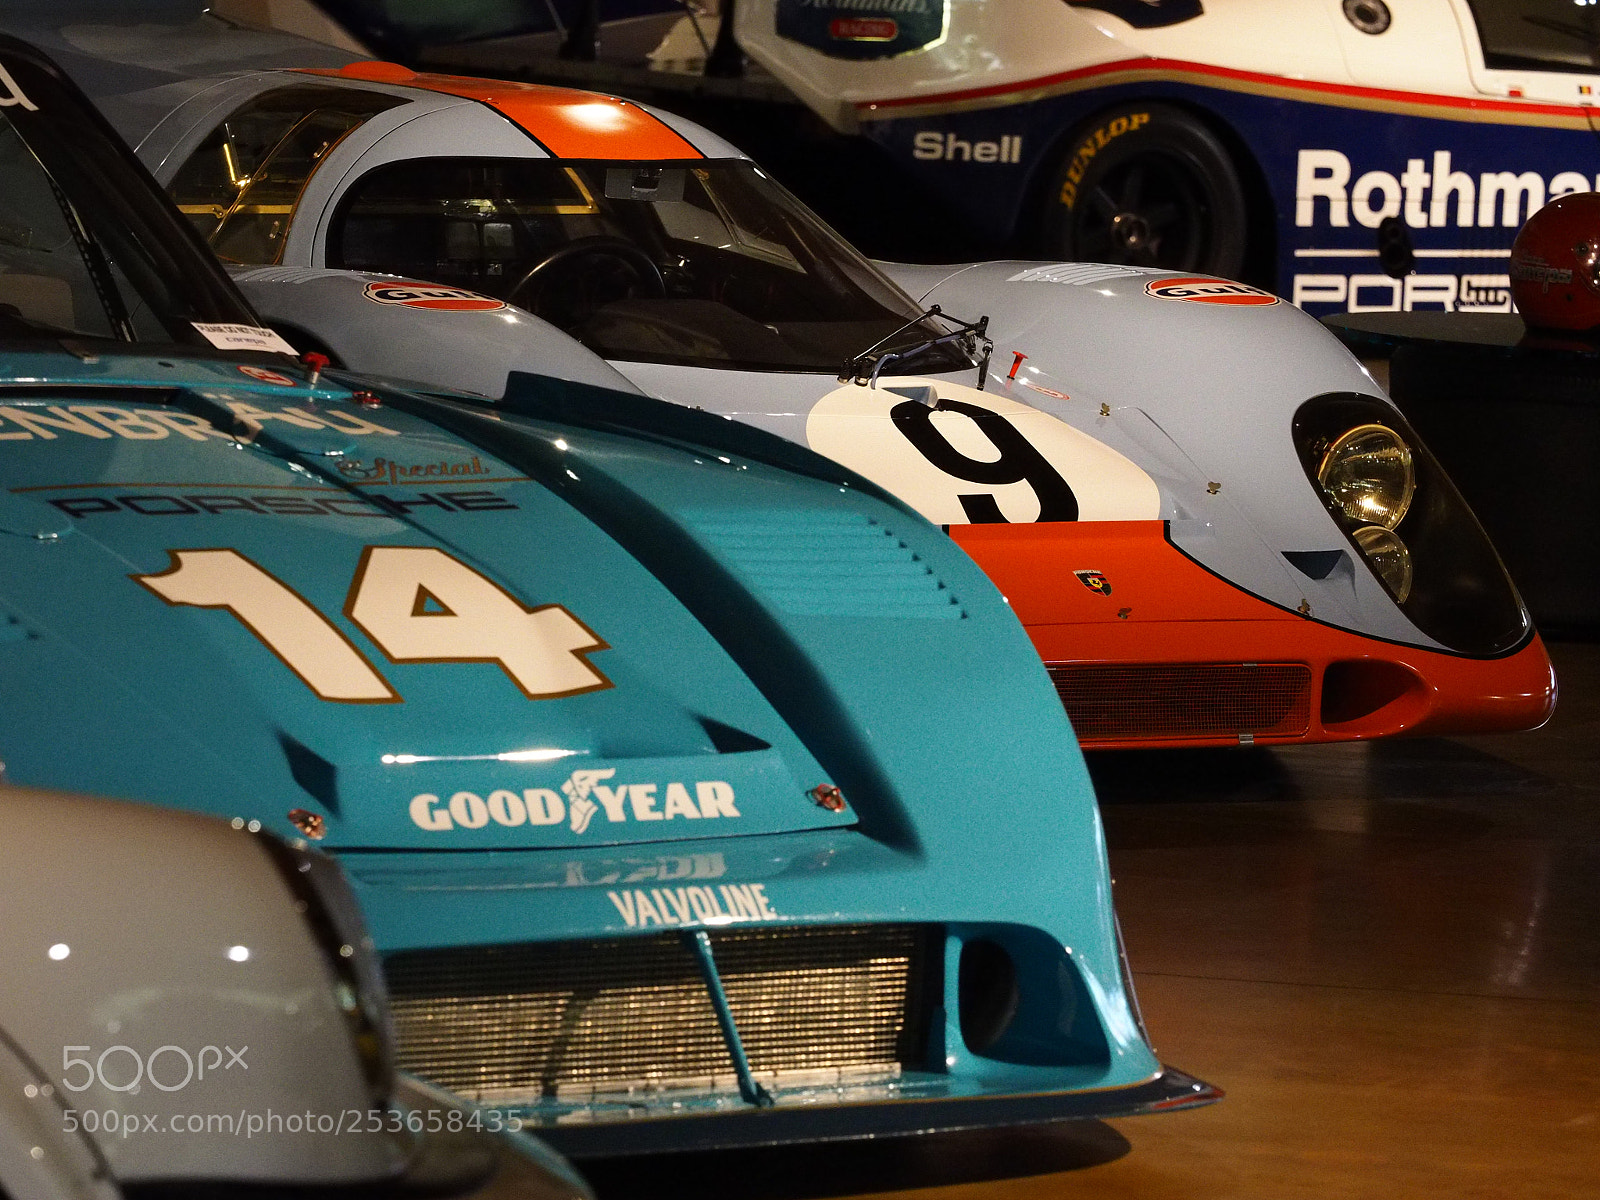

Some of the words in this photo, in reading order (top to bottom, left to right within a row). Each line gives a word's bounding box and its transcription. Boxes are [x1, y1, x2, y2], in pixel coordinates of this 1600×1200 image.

[913, 132, 1022, 164] Shell
[1060, 112, 1150, 210] DUNLOP
[336, 457, 490, 485] Special
[890, 398, 1079, 524] 9
[47, 490, 520, 519] PORSCHE
[127, 544, 616, 705] 14
[609, 884, 776, 928] VALVOLINE
